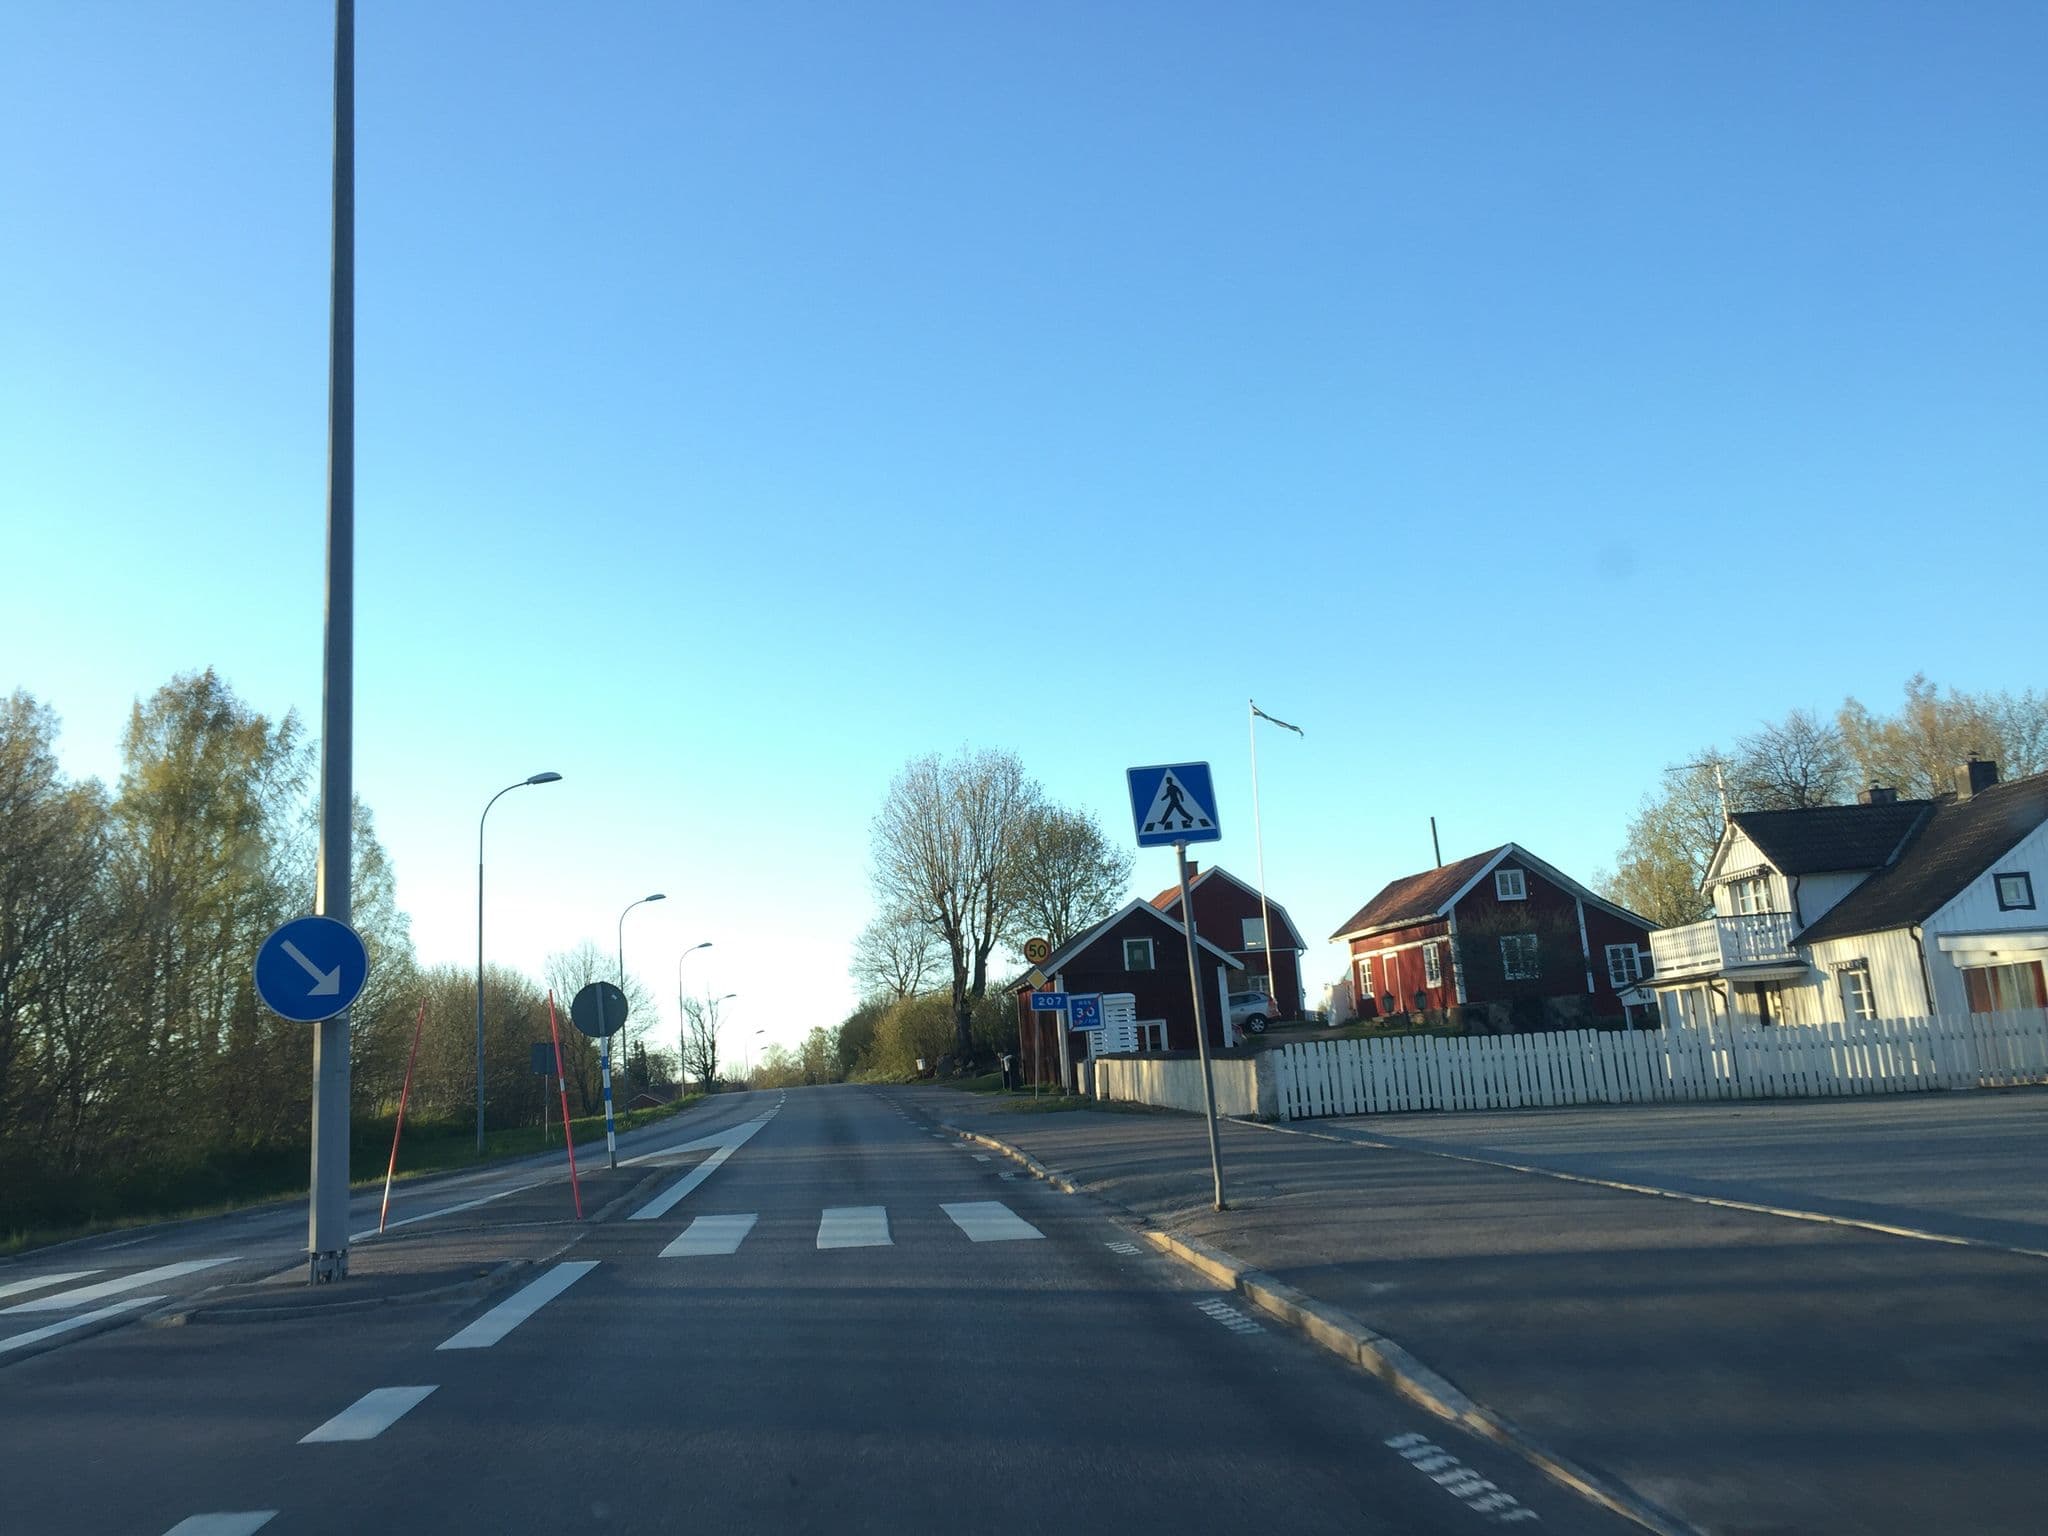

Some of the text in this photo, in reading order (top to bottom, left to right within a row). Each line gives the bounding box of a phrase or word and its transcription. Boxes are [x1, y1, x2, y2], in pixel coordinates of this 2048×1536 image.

[1029, 944, 1047, 958] 50
[1038, 996, 1062, 1006] 207
[1076, 1006, 1095, 1018] 30
